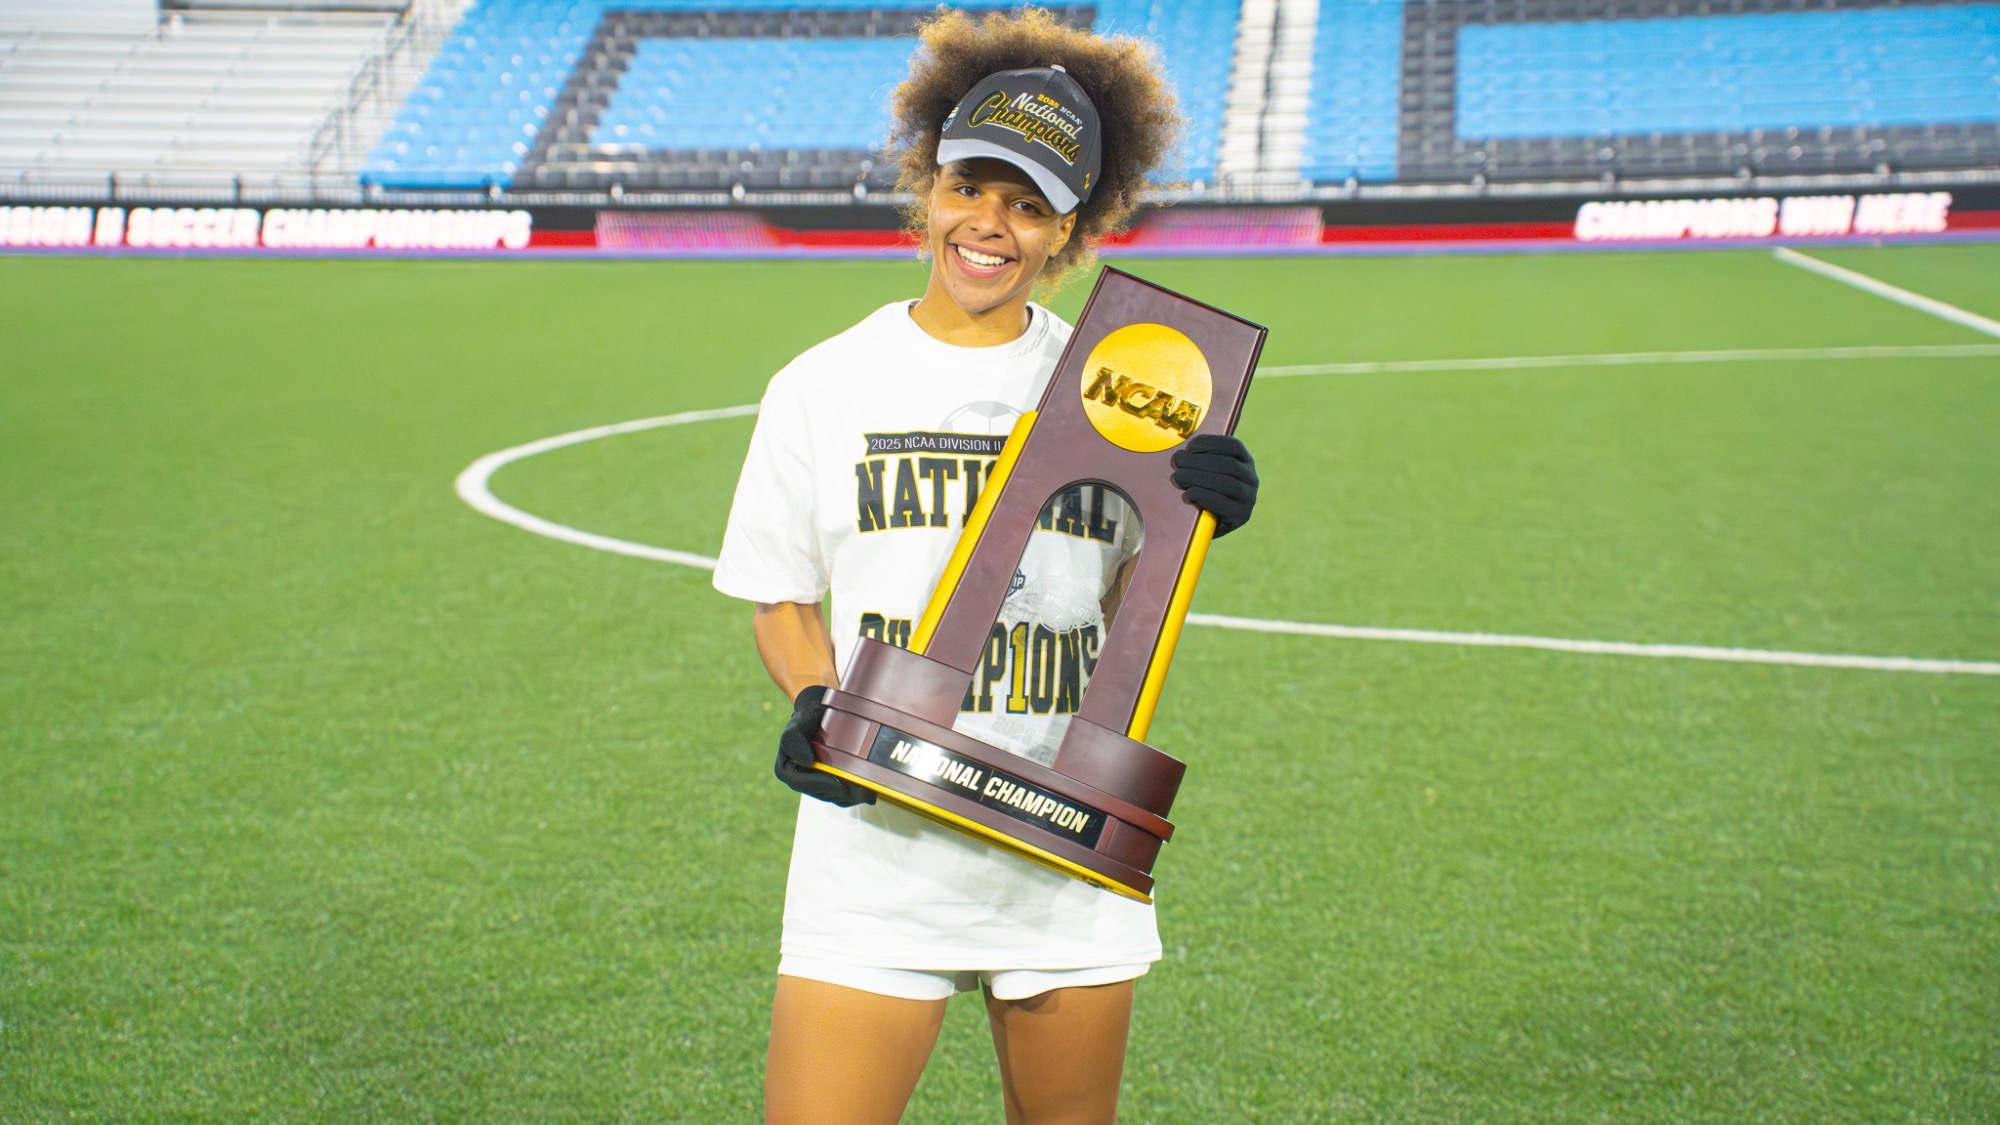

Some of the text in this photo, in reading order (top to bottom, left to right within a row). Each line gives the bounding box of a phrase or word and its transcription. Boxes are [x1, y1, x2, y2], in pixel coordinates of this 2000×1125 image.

[968, 90, 1080, 162] Champions
[1010, 92, 1083, 139] National
[95, 206, 125, 247] II
[127, 207, 261, 247] SOCCER
[262, 208, 532, 249] CHAMPIONSHIPS
[1575, 192, 1952, 241] CHAMPIONS WIN HERE
[1084, 367, 1202, 439] NCAA
[871, 438, 901, 450] 2025
[904, 436, 936, 449] NCAA
[939, 437, 990, 451] DIVISION
[983, 776, 1090, 834] CHAMPION
